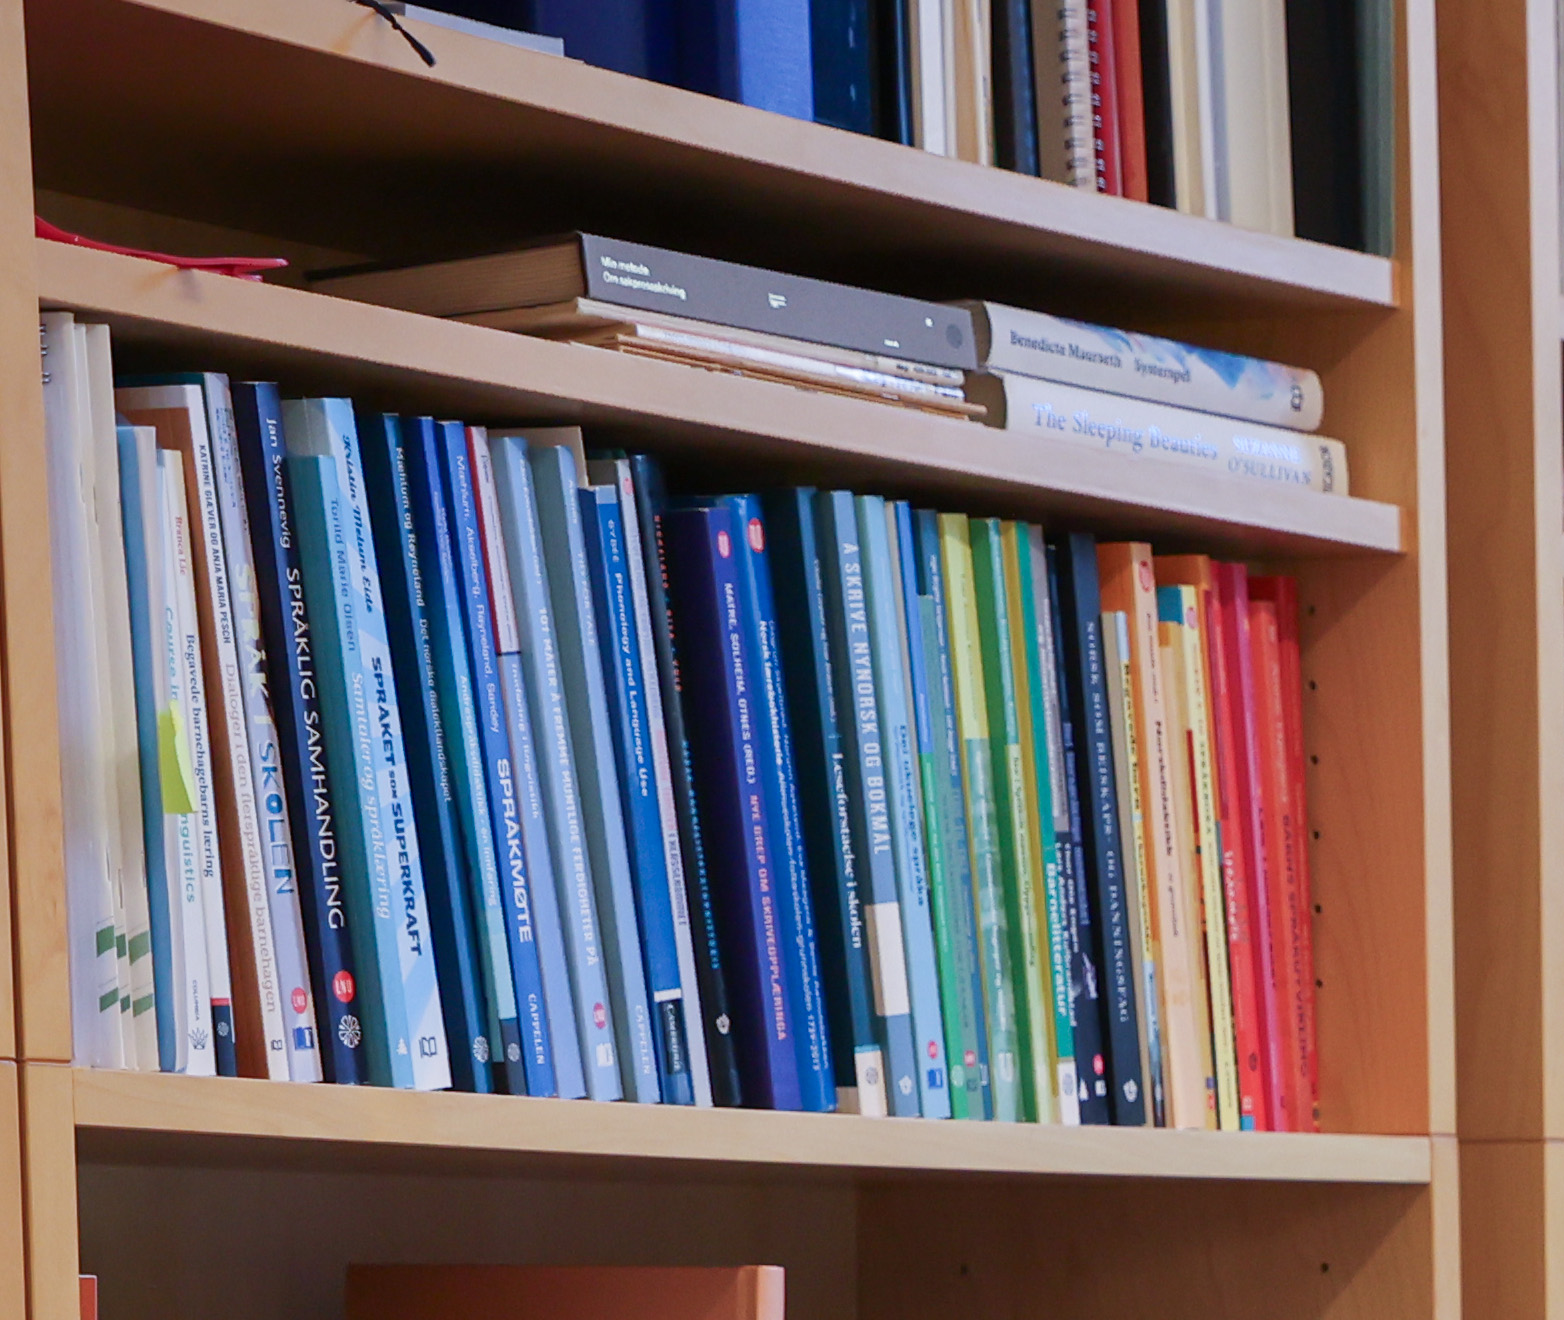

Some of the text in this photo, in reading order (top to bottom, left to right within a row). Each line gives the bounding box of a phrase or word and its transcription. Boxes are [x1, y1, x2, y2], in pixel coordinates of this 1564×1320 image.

[199, 444, 212, 488] KATRINE
[1033, 403, 1217, 460] The Sleeping Beauties
[212, 549, 223, 574] ANJA
[215, 576, 227, 608] MARIA
[219, 611, 231, 644] PESCH
[419, 618, 430, 640] Det
[615, 573, 630, 655] Phonology
[185, 634, 200, 703] Begavede
[226, 663, 243, 739] Dialoger
[267, 418, 345, 929] Jan Svennevig SPRÅKLIG SAMHANDLING
[342, 434, 422, 956] Kristin Eide SPRÅKET SUPERKRAFT
[422, 644, 435, 686] norske
[625, 658, 635, 686] and
[235, 563, 295, 895] SPRÅK SKOLEN
[337, 550, 393, 919] Marie Olsen Samtaler og språklæring
[628, 690, 649, 763] Language
[845, 563, 892, 855] SKRIVE NYNORSK OG BOKMÅL
[192, 707, 211, 826] barnehagebarns
[236, 753, 249, 788] den
[202, 830, 216, 878] læring
[240, 792, 265, 902] flerspråklige
[496, 759, 532, 943] SPRÅKMØTE
[552, 707, 598, 966] FREMME MUNTLIGE FERDIGHETER PÅ
[757, 868, 769, 892] OM
[848, 890, 863, 949] skolen
[255, 906, 278, 1014] barnehagen
[528, 993, 544, 1065] CAPPELEN
